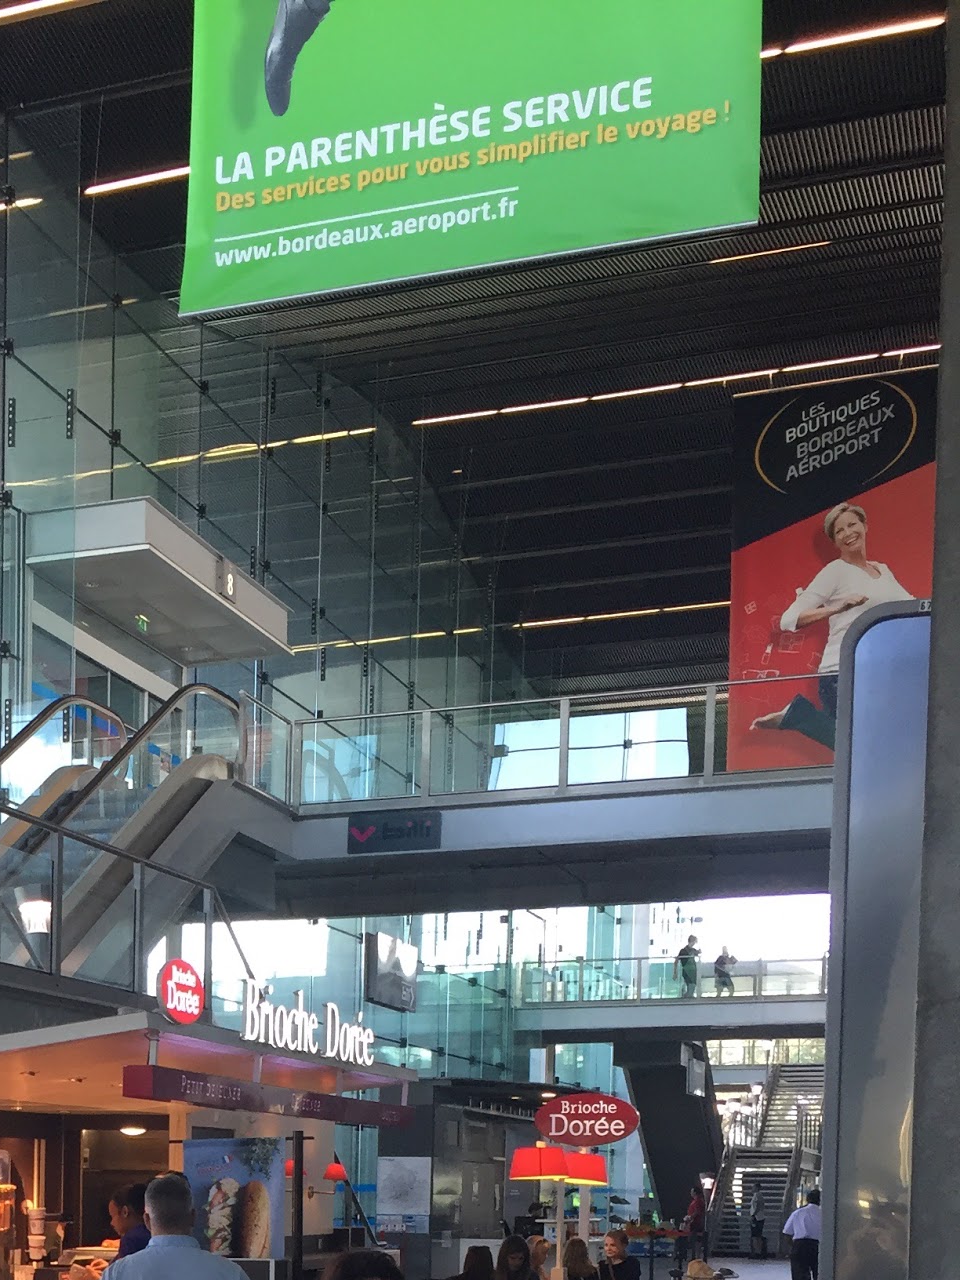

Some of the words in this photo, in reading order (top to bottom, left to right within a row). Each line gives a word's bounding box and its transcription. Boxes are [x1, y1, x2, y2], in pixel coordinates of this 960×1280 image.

[215, 151, 254, 185] LA
[265, 102, 491, 177] PARENTHÈSE
[503, 76, 653, 133] SERVICE
[216, 191, 255, 212] Des
[261, 175, 351, 205] services
[357, 162, 409, 192] pour
[415, 150, 471, 177] vous
[477, 129, 591, 164] simplifier
[596, 123, 619, 145] le
[626, 107, 717, 140] voyage
[214, 196, 519, 267] www.bordeaux.aeroport.fr
[785, 390, 881, 444] BOUTIQUES
[796, 403, 896, 459] BORDEAUX
[801, 401, 826, 422] LES
[785, 426, 884, 482] AÉROPORT
[227, 573, 234, 596] 8
[243, 978, 319, 1054] Brioche
[324, 1002, 375, 1067] Dorée
[548, 1113, 626, 1136] Dorée
[560, 1100, 617, 1114] Brioche
